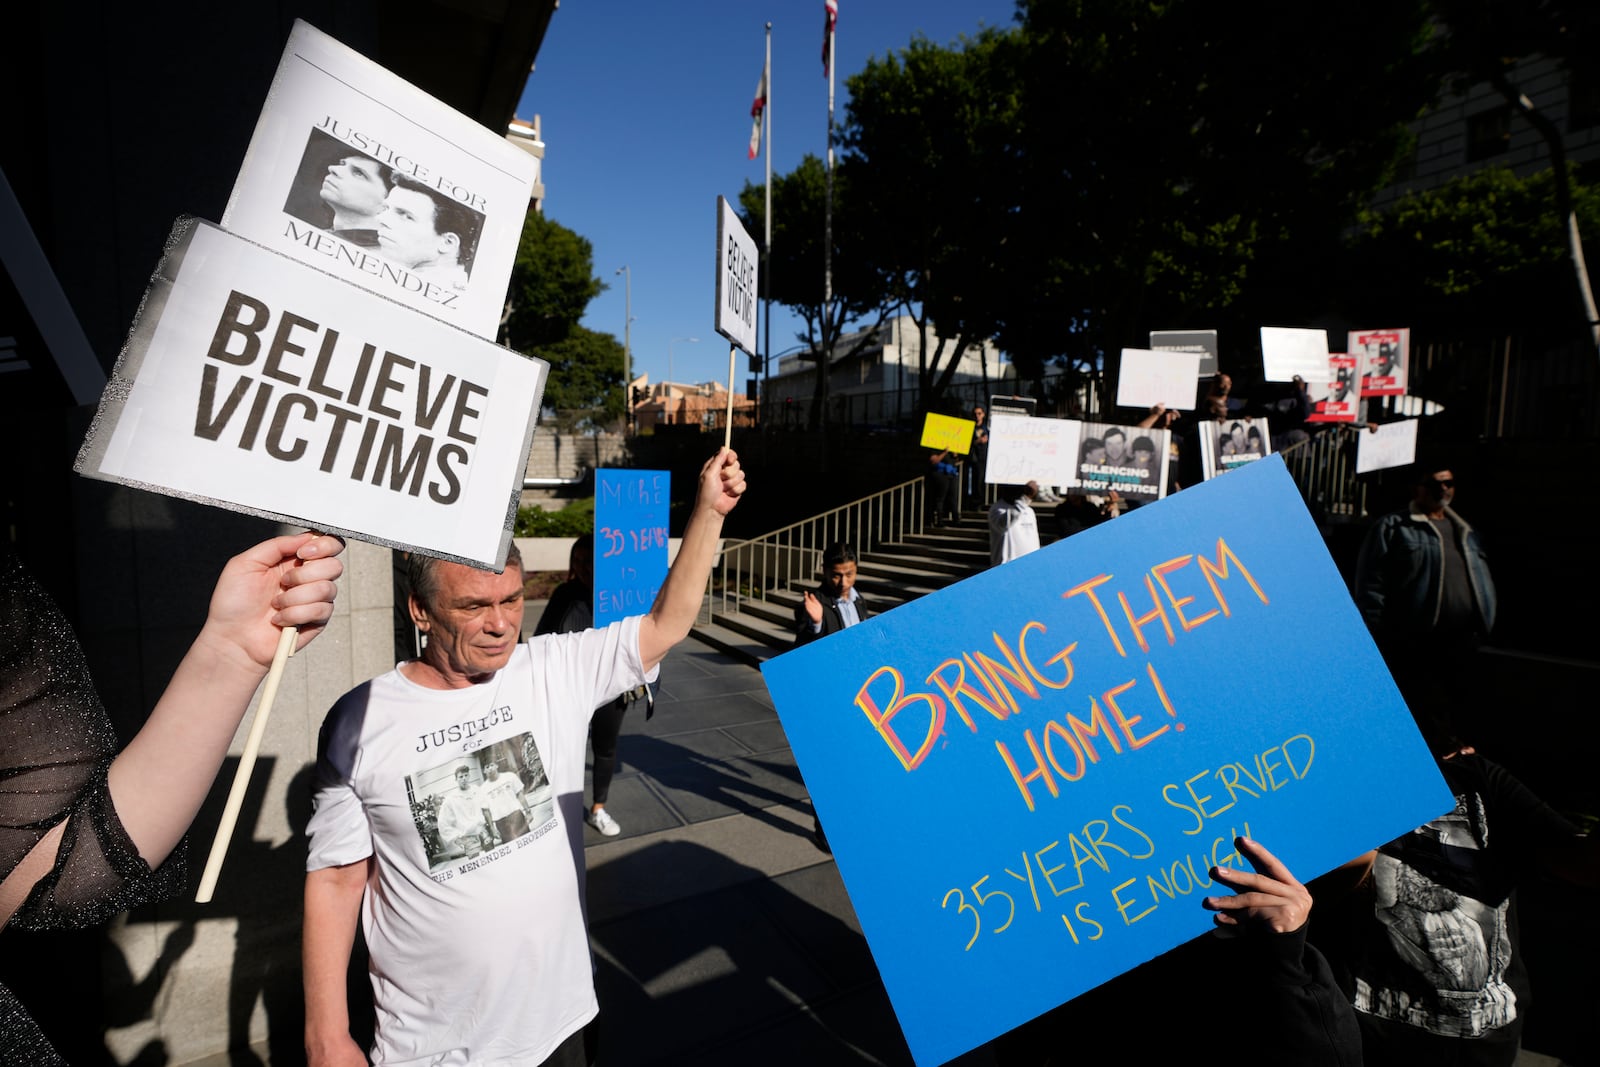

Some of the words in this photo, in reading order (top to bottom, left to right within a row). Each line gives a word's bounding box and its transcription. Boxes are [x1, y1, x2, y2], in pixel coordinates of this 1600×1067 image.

[317, 115, 429, 182] JUSTICE
[437, 177, 487, 211] FOR
[283, 221, 460, 309] MENENDEZ
[728, 234, 754, 297] BELIEVE
[727, 272, 753, 329] VICTIMS
[207, 289, 489, 445] BELIEVE
[194, 363, 469, 505] VICTIMS
[602, 475, 662, 506] MORE
[1081, 464, 1150, 478] SILENCING
[1083, 478, 1108, 491] NOT
[1108, 482, 1159, 494] JUSTICE
[630, 527, 669, 553] YEARS
[599, 588, 660, 613] ENOUG
[854, 621, 1078, 771] BRING
[1062, 537, 1270, 658] THEM
[416, 705, 514, 753] JUSTICE
[462, 738, 483, 752] for
[995, 662, 1186, 812] HOME!
[431, 868, 454, 883] THE
[458, 846, 513, 875] MENENDEZ
[516, 818, 559, 850] BROTHERS
[942, 874, 1015, 951] 35
[1005, 804, 1155, 912] YEARS
[1162, 733, 1316, 835] SERVED
[1062, 901, 1104, 945] IS
